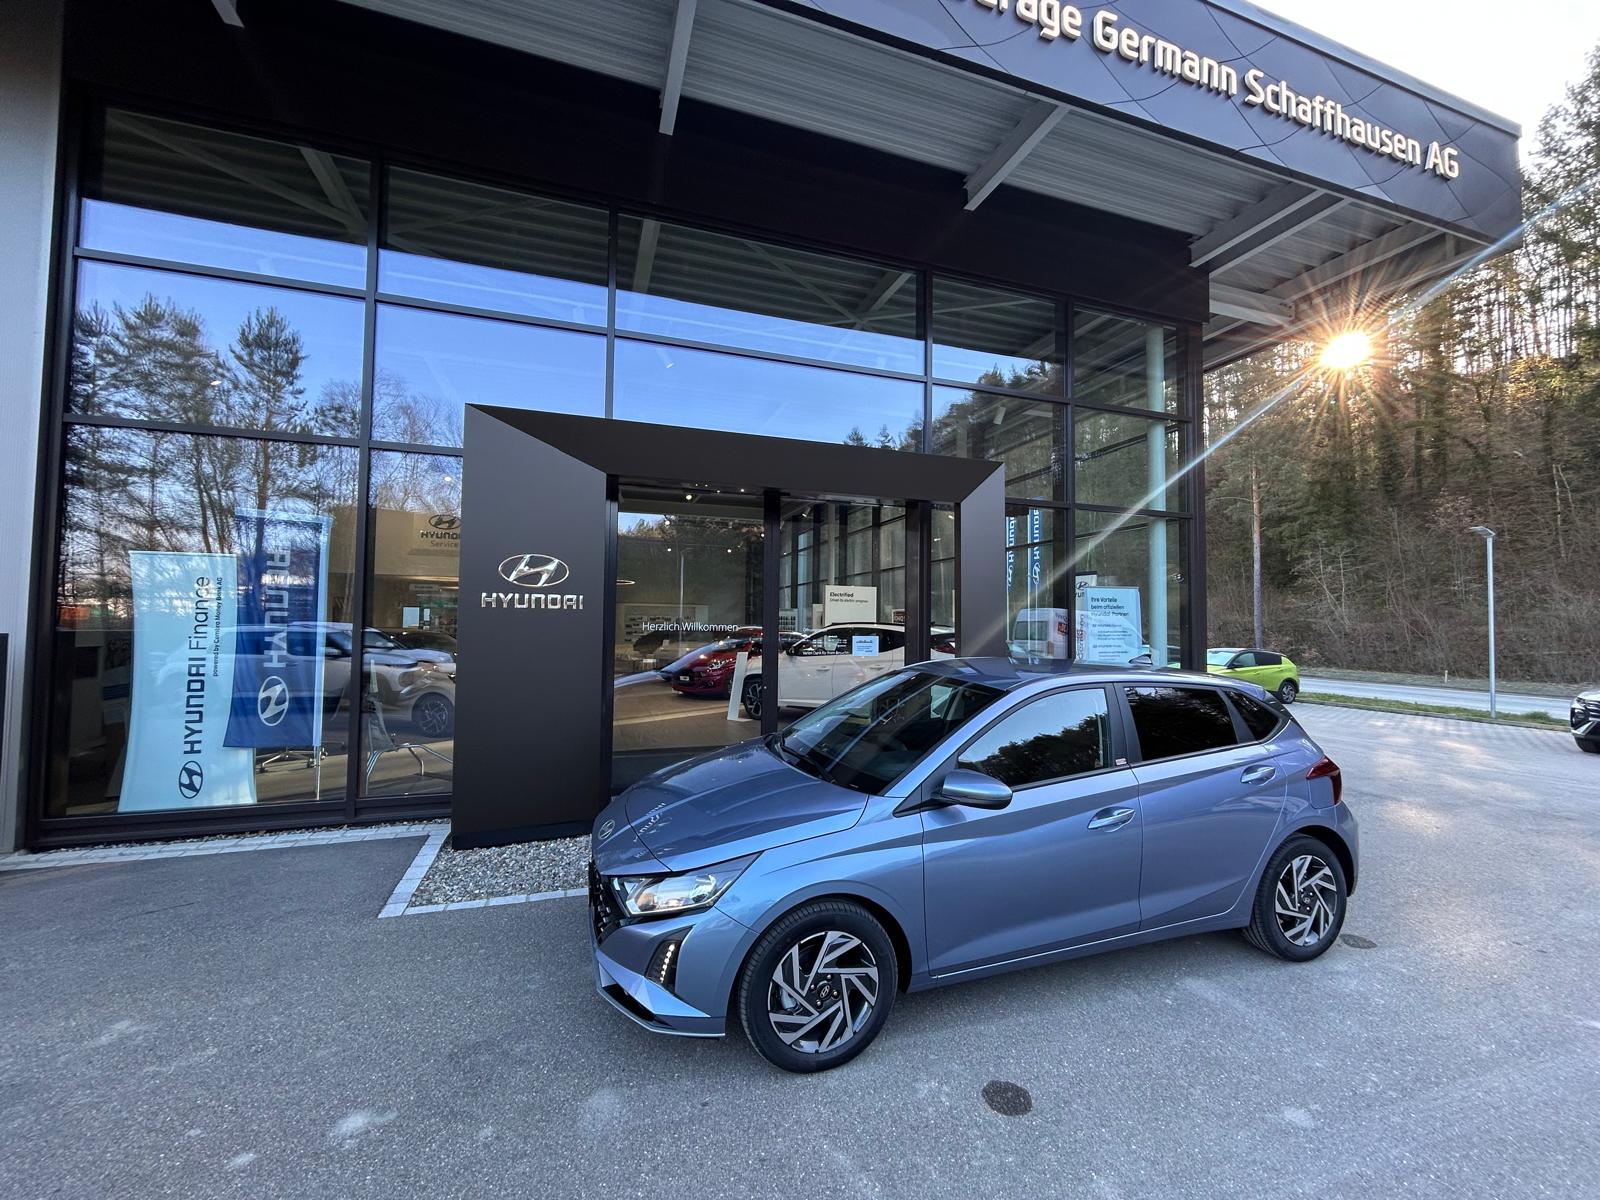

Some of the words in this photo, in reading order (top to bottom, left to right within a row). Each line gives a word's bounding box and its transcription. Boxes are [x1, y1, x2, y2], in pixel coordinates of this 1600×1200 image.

[1093, 10, 1238, 96] Germann
[1244, 68, 1421, 166] Schaffhausen
[1425, 141, 1460, 179] AG
[430, 540, 459, 548] Service
[189, 576, 210, 650] Finance
[480, 592, 584, 610] HYUNDAI
[642, 622, 680, 631] Herzlich
[681, 622, 738, 631] Willkommen
[184, 657, 206, 755] HYUNDAI
